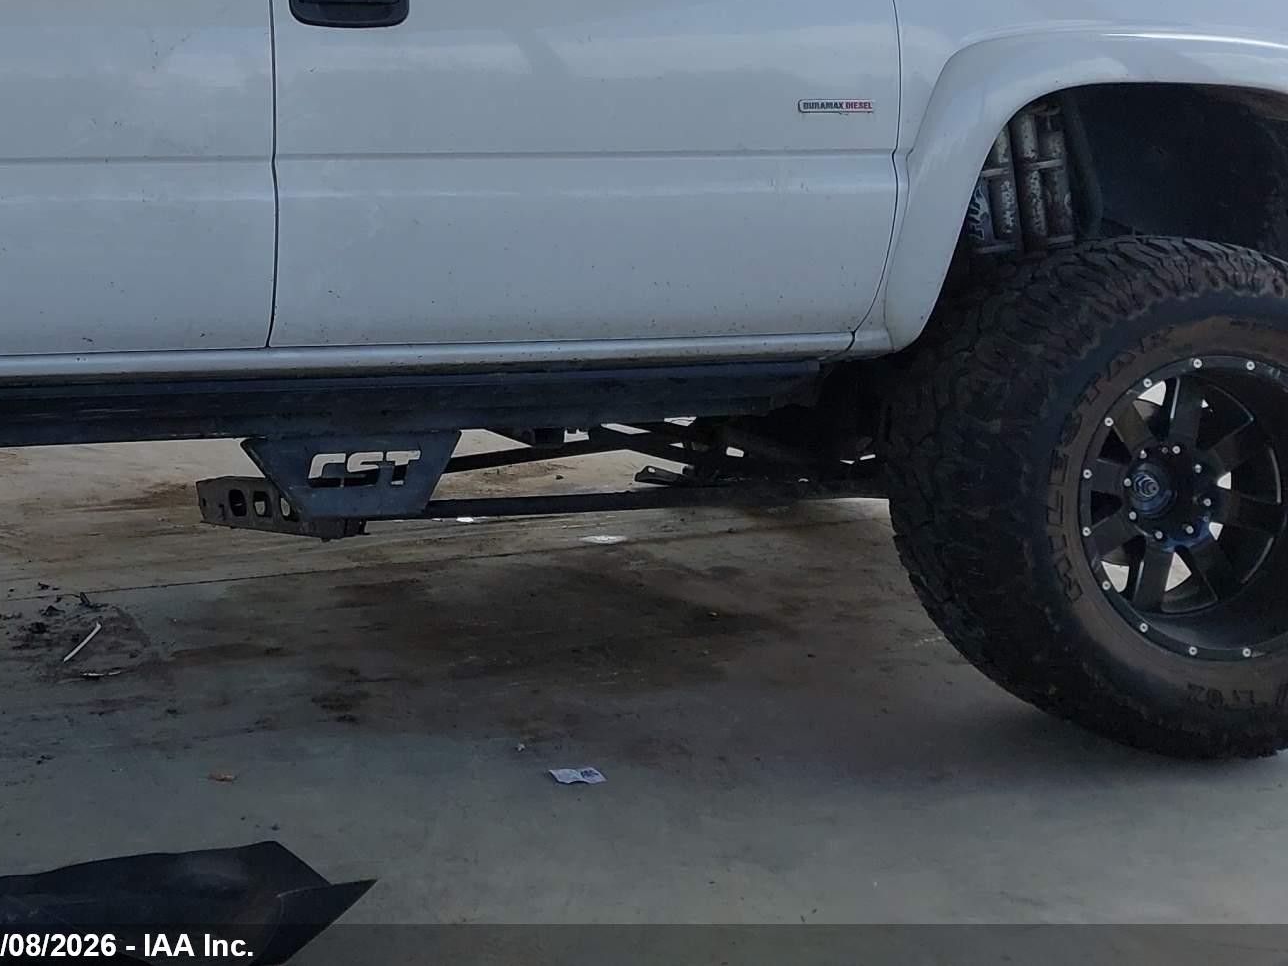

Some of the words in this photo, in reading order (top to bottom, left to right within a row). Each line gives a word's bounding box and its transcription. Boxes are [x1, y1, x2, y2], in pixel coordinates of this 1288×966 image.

[802, 101, 844, 110] DURAMAX
[845, 101, 873, 110] DIESEL
[307, 449, 422, 488] CST
